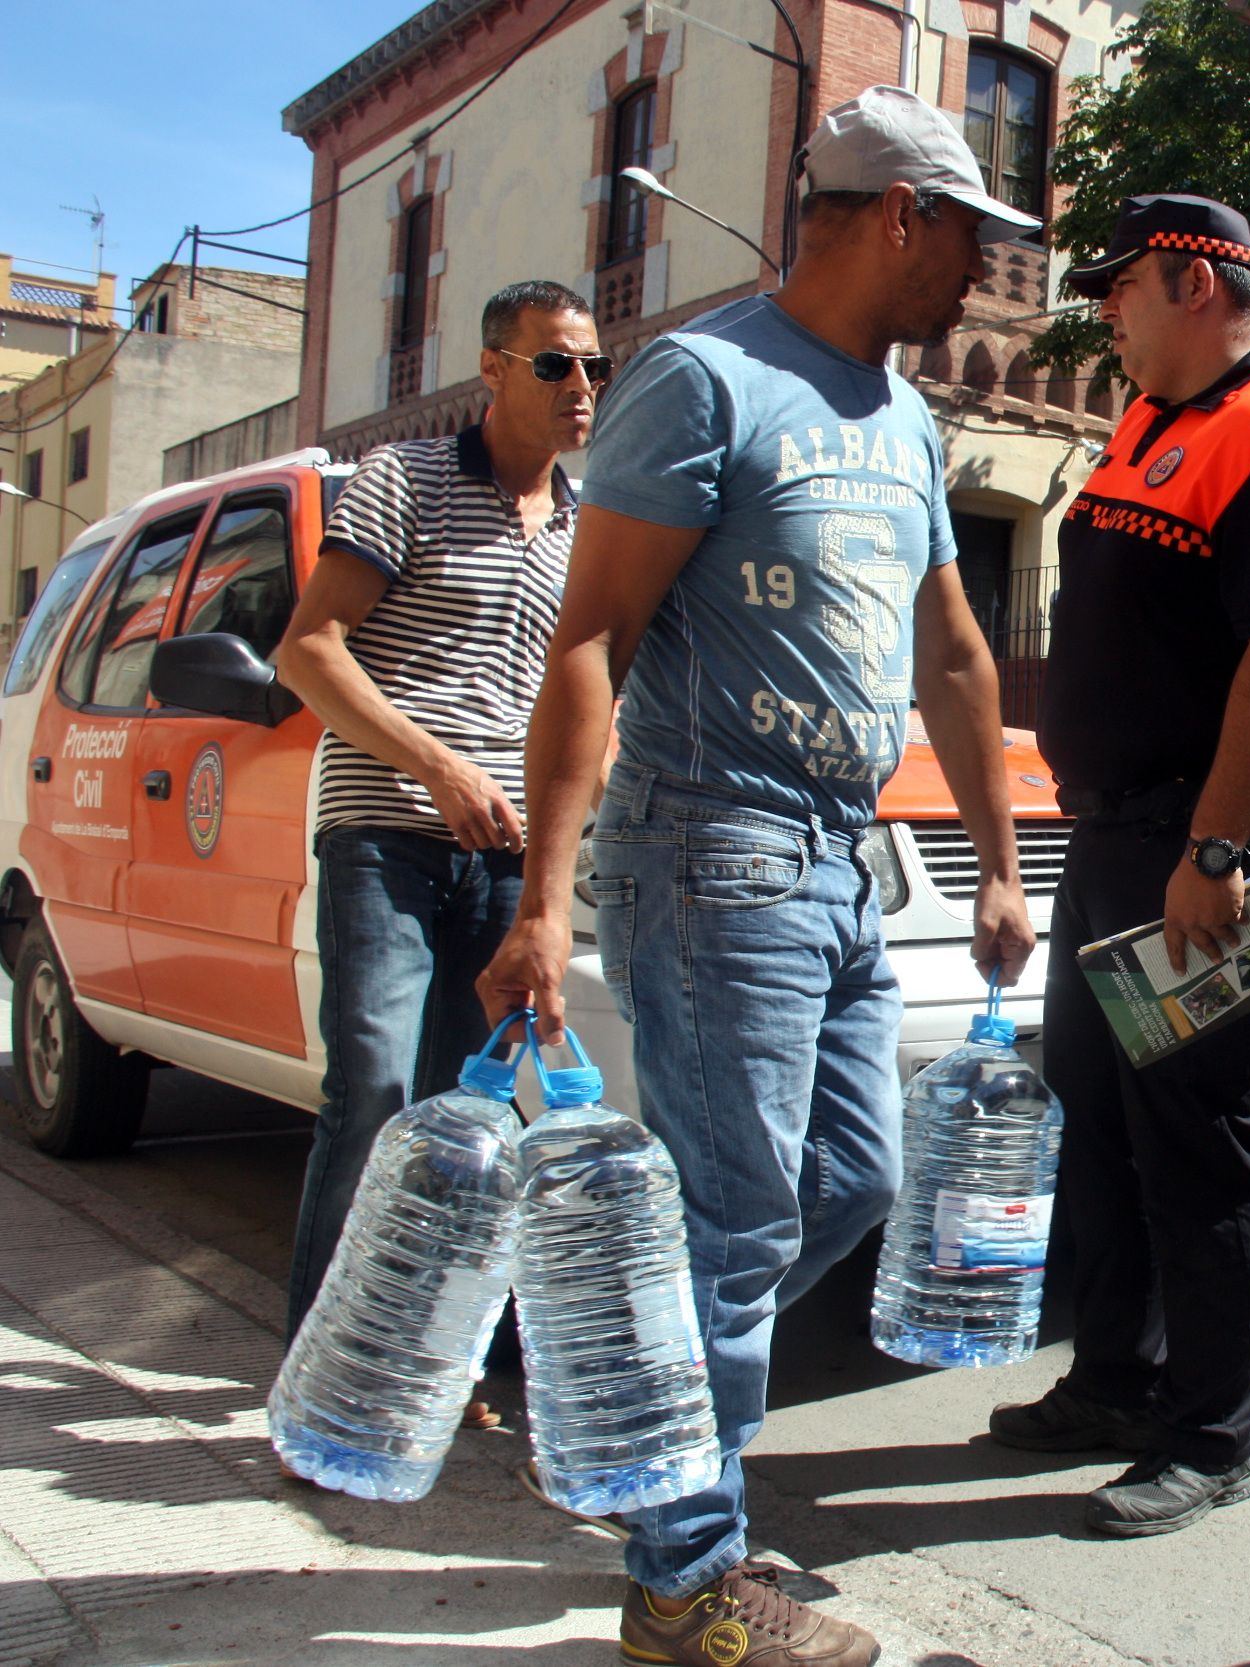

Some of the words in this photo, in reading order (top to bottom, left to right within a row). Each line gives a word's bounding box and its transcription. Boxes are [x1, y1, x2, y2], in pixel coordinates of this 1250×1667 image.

[776, 424, 928, 489] ALBANY
[809, 478, 917, 508] CHAMPIONS
[740, 561, 796, 609] 19
[62, 720, 132, 759] Protecció
[74, 770, 104, 809] Civil
[1110, 970, 1127, 992] HORT
